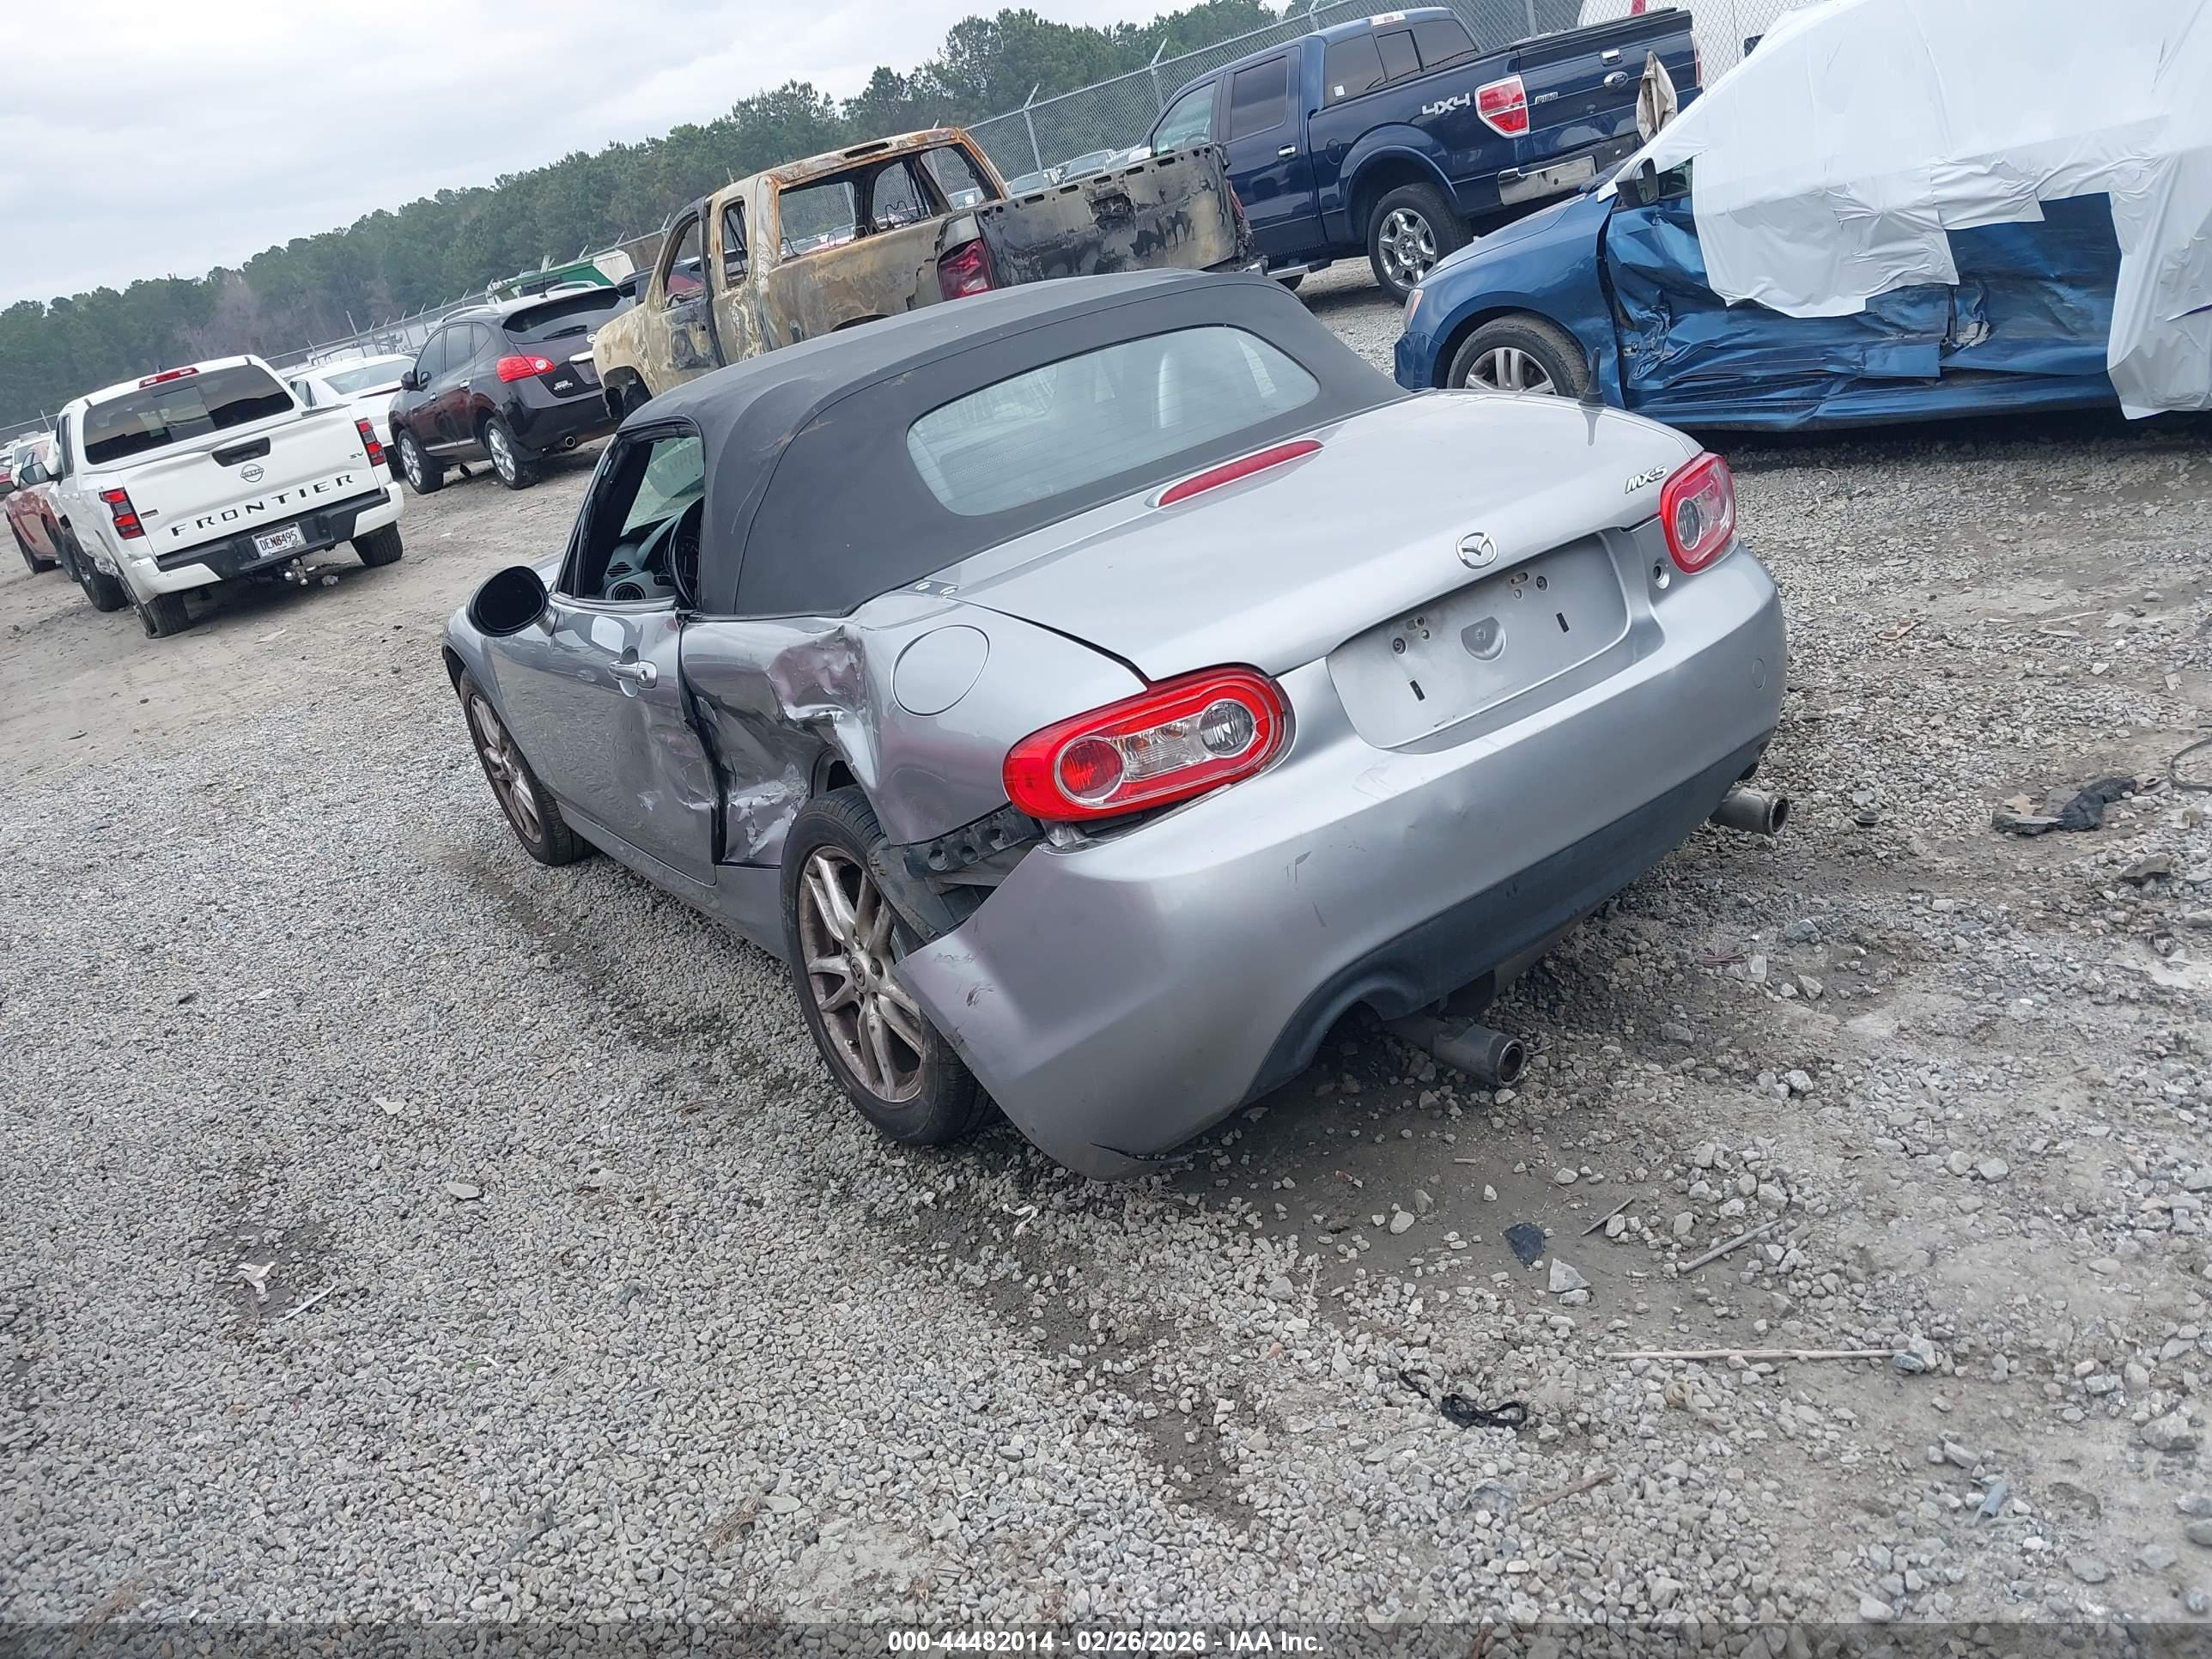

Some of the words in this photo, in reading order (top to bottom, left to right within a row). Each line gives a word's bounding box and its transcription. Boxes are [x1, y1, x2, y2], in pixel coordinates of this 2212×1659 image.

[349, 451, 364, 459] SV
[1625, 465, 1668, 494] MX-5
[171, 474, 354, 537] FRONTIER
